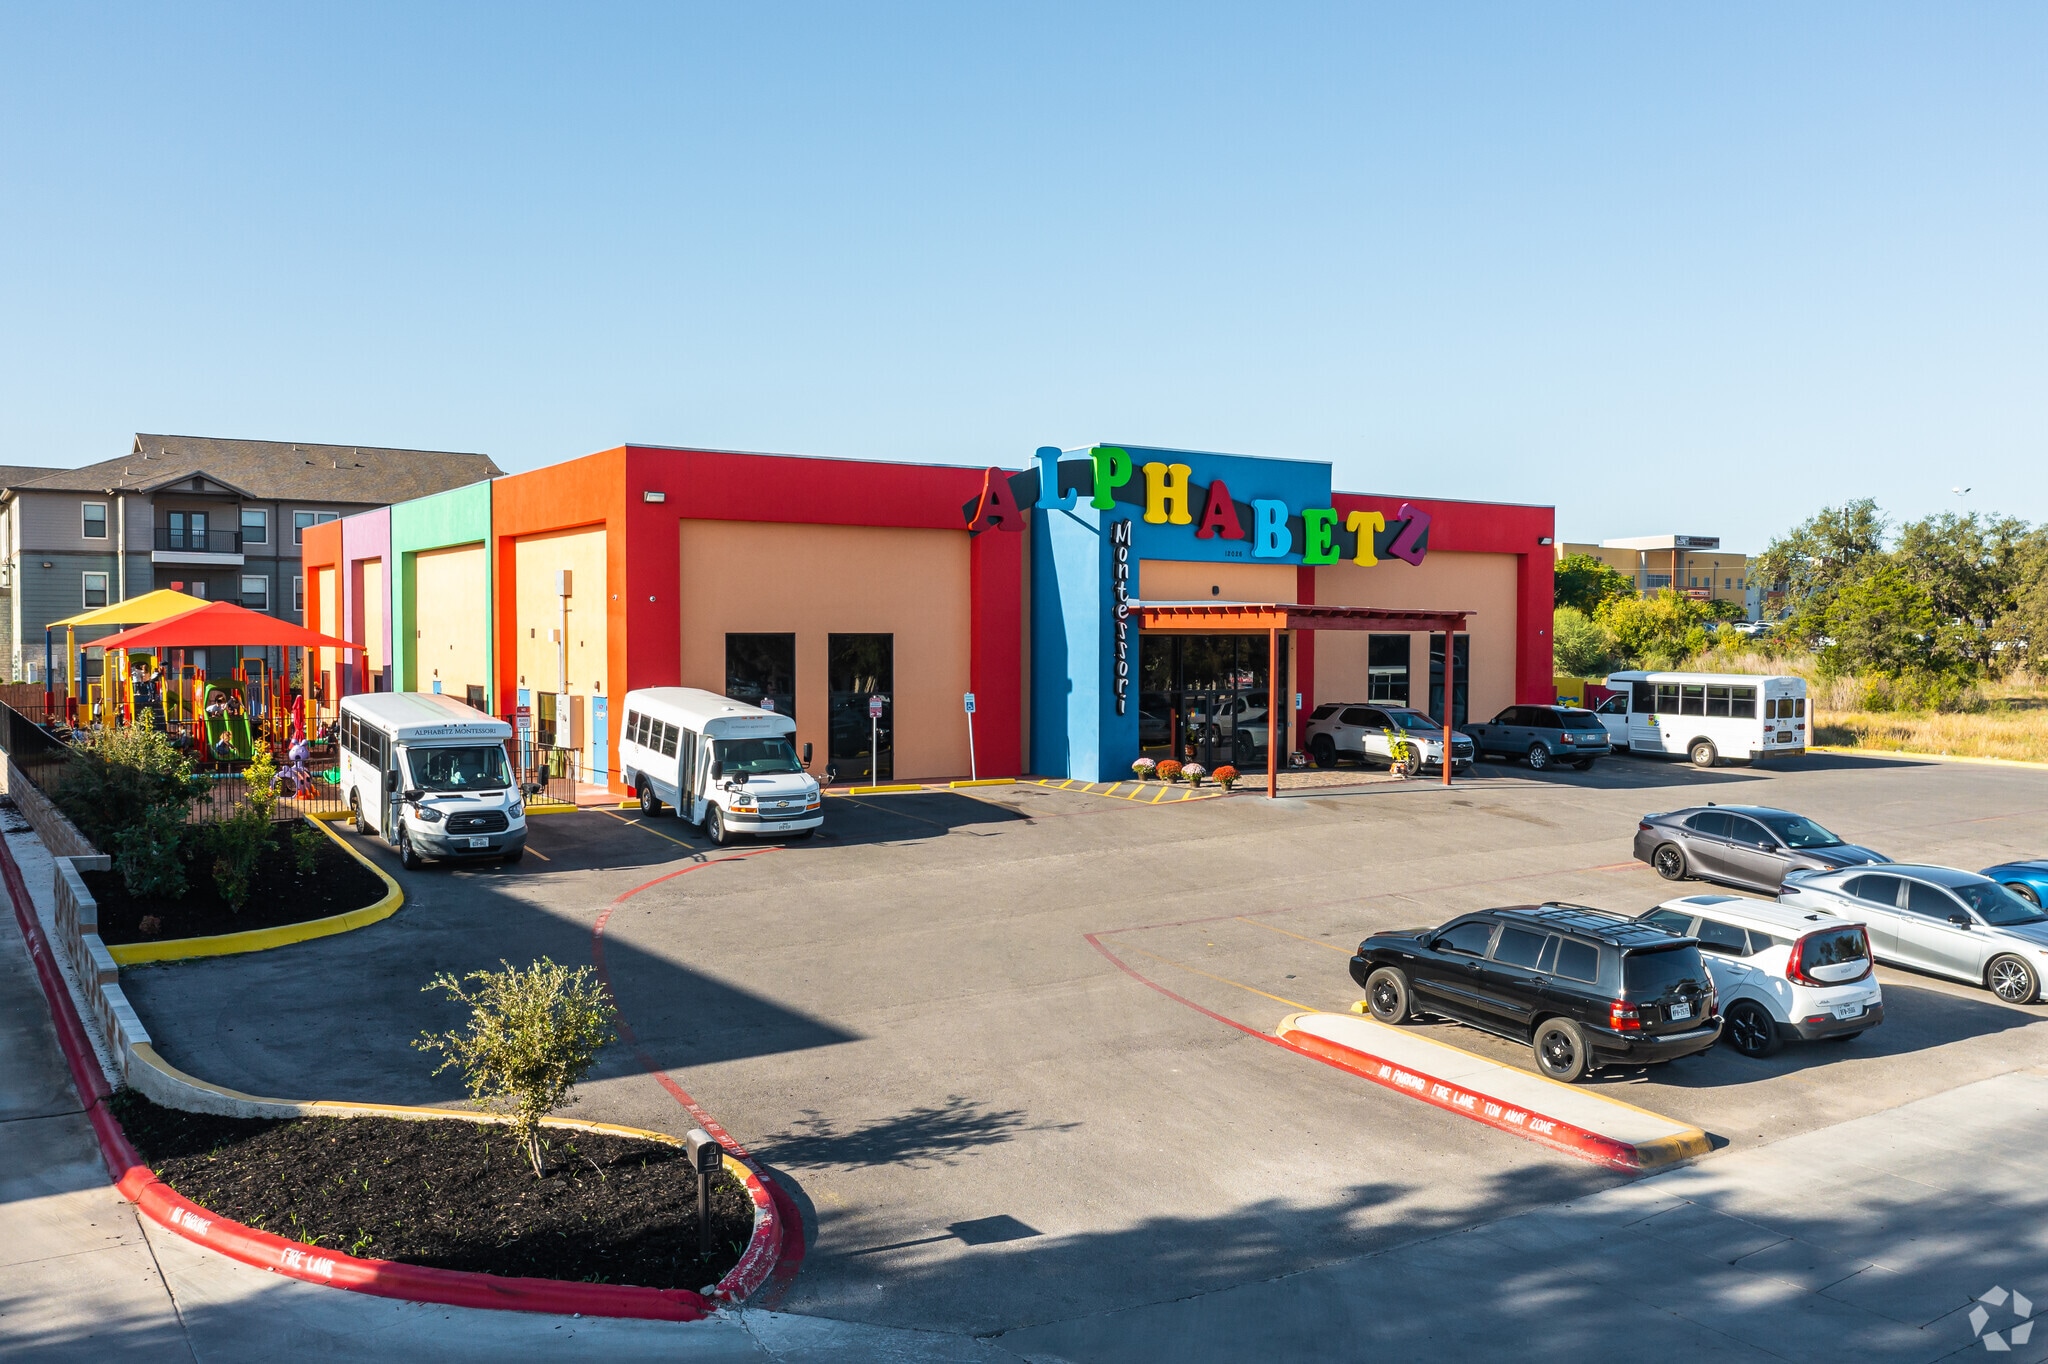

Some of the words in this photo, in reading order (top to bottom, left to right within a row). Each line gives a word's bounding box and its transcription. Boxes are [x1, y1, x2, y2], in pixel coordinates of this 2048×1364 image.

[968, 446, 1432, 567] ALPHABETZ
[1112, 518, 1132, 715] Montessori
[1378, 1064, 1392, 1079] NO
[1392, 1069, 1426, 1091] PARKING
[1431, 1083, 1452, 1101] FIRE
[1453, 1091, 1478, 1110] LANE
[1484, 1102, 1503, 1118] TOW
[1503, 1109, 1528, 1126] AWAY
[1529, 1117, 1557, 1135] ZONE
[182, 1212, 212, 1236] PARKING
[280, 1247, 306, 1271] FIRE
[307, 1255, 337, 1279] LANE
